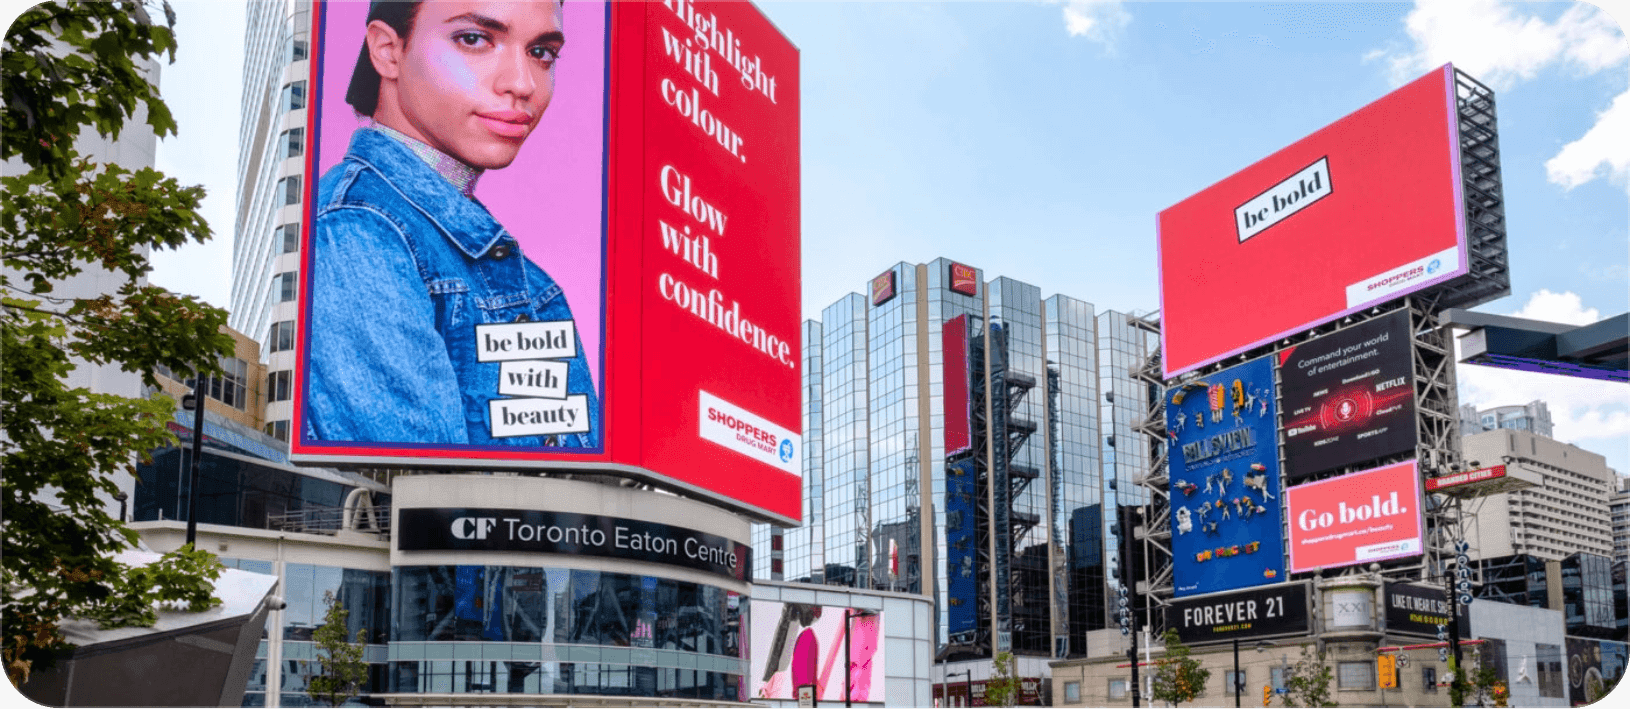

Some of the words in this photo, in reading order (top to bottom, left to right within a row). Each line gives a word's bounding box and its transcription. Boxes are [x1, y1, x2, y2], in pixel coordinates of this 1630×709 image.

[661, 26, 719, 97] with
[661, 78, 746, 163] colour.
[660, 165, 728, 236] Glow
[1244, 207, 1269, 229] be
[1272, 170, 1322, 213] bold
[659, 219, 719, 280] with
[954, 264, 976, 281] CIBC
[1366, 265, 1425, 291] SHOPPERS
[659, 272, 795, 369] confidence.
[484, 333, 512, 353] be
[517, 329, 568, 351] bold
[1298, 347, 1341, 369] Command
[1342, 342, 1362, 357] your
[1363, 331, 1389, 347] world
[508, 368, 558, 389] with
[1307, 365, 1317, 377] of
[1318, 348, 1380, 373] entertainment.
[1375, 376, 1406, 393] NETFLIX
[501, 404, 579, 428] beauty
[707, 406, 778, 447] SHOPPERS
[736, 433, 757, 448] DRUG
[757, 442, 777, 456] MART
[1298, 508, 1334, 532] Go
[1338, 491, 1408, 524] bold.
[451, 516, 497, 540] CF
[503, 517, 606, 547] Toronto
[615, 526, 678, 556] Eaton
[684, 537, 738, 569] Centre
[1215, 540, 1261, 558] MAGET
[1455, 540, 1474, 606] Yonge
[1184, 599, 1258, 628] FOREVER
[1266, 595, 1284, 618] 21
